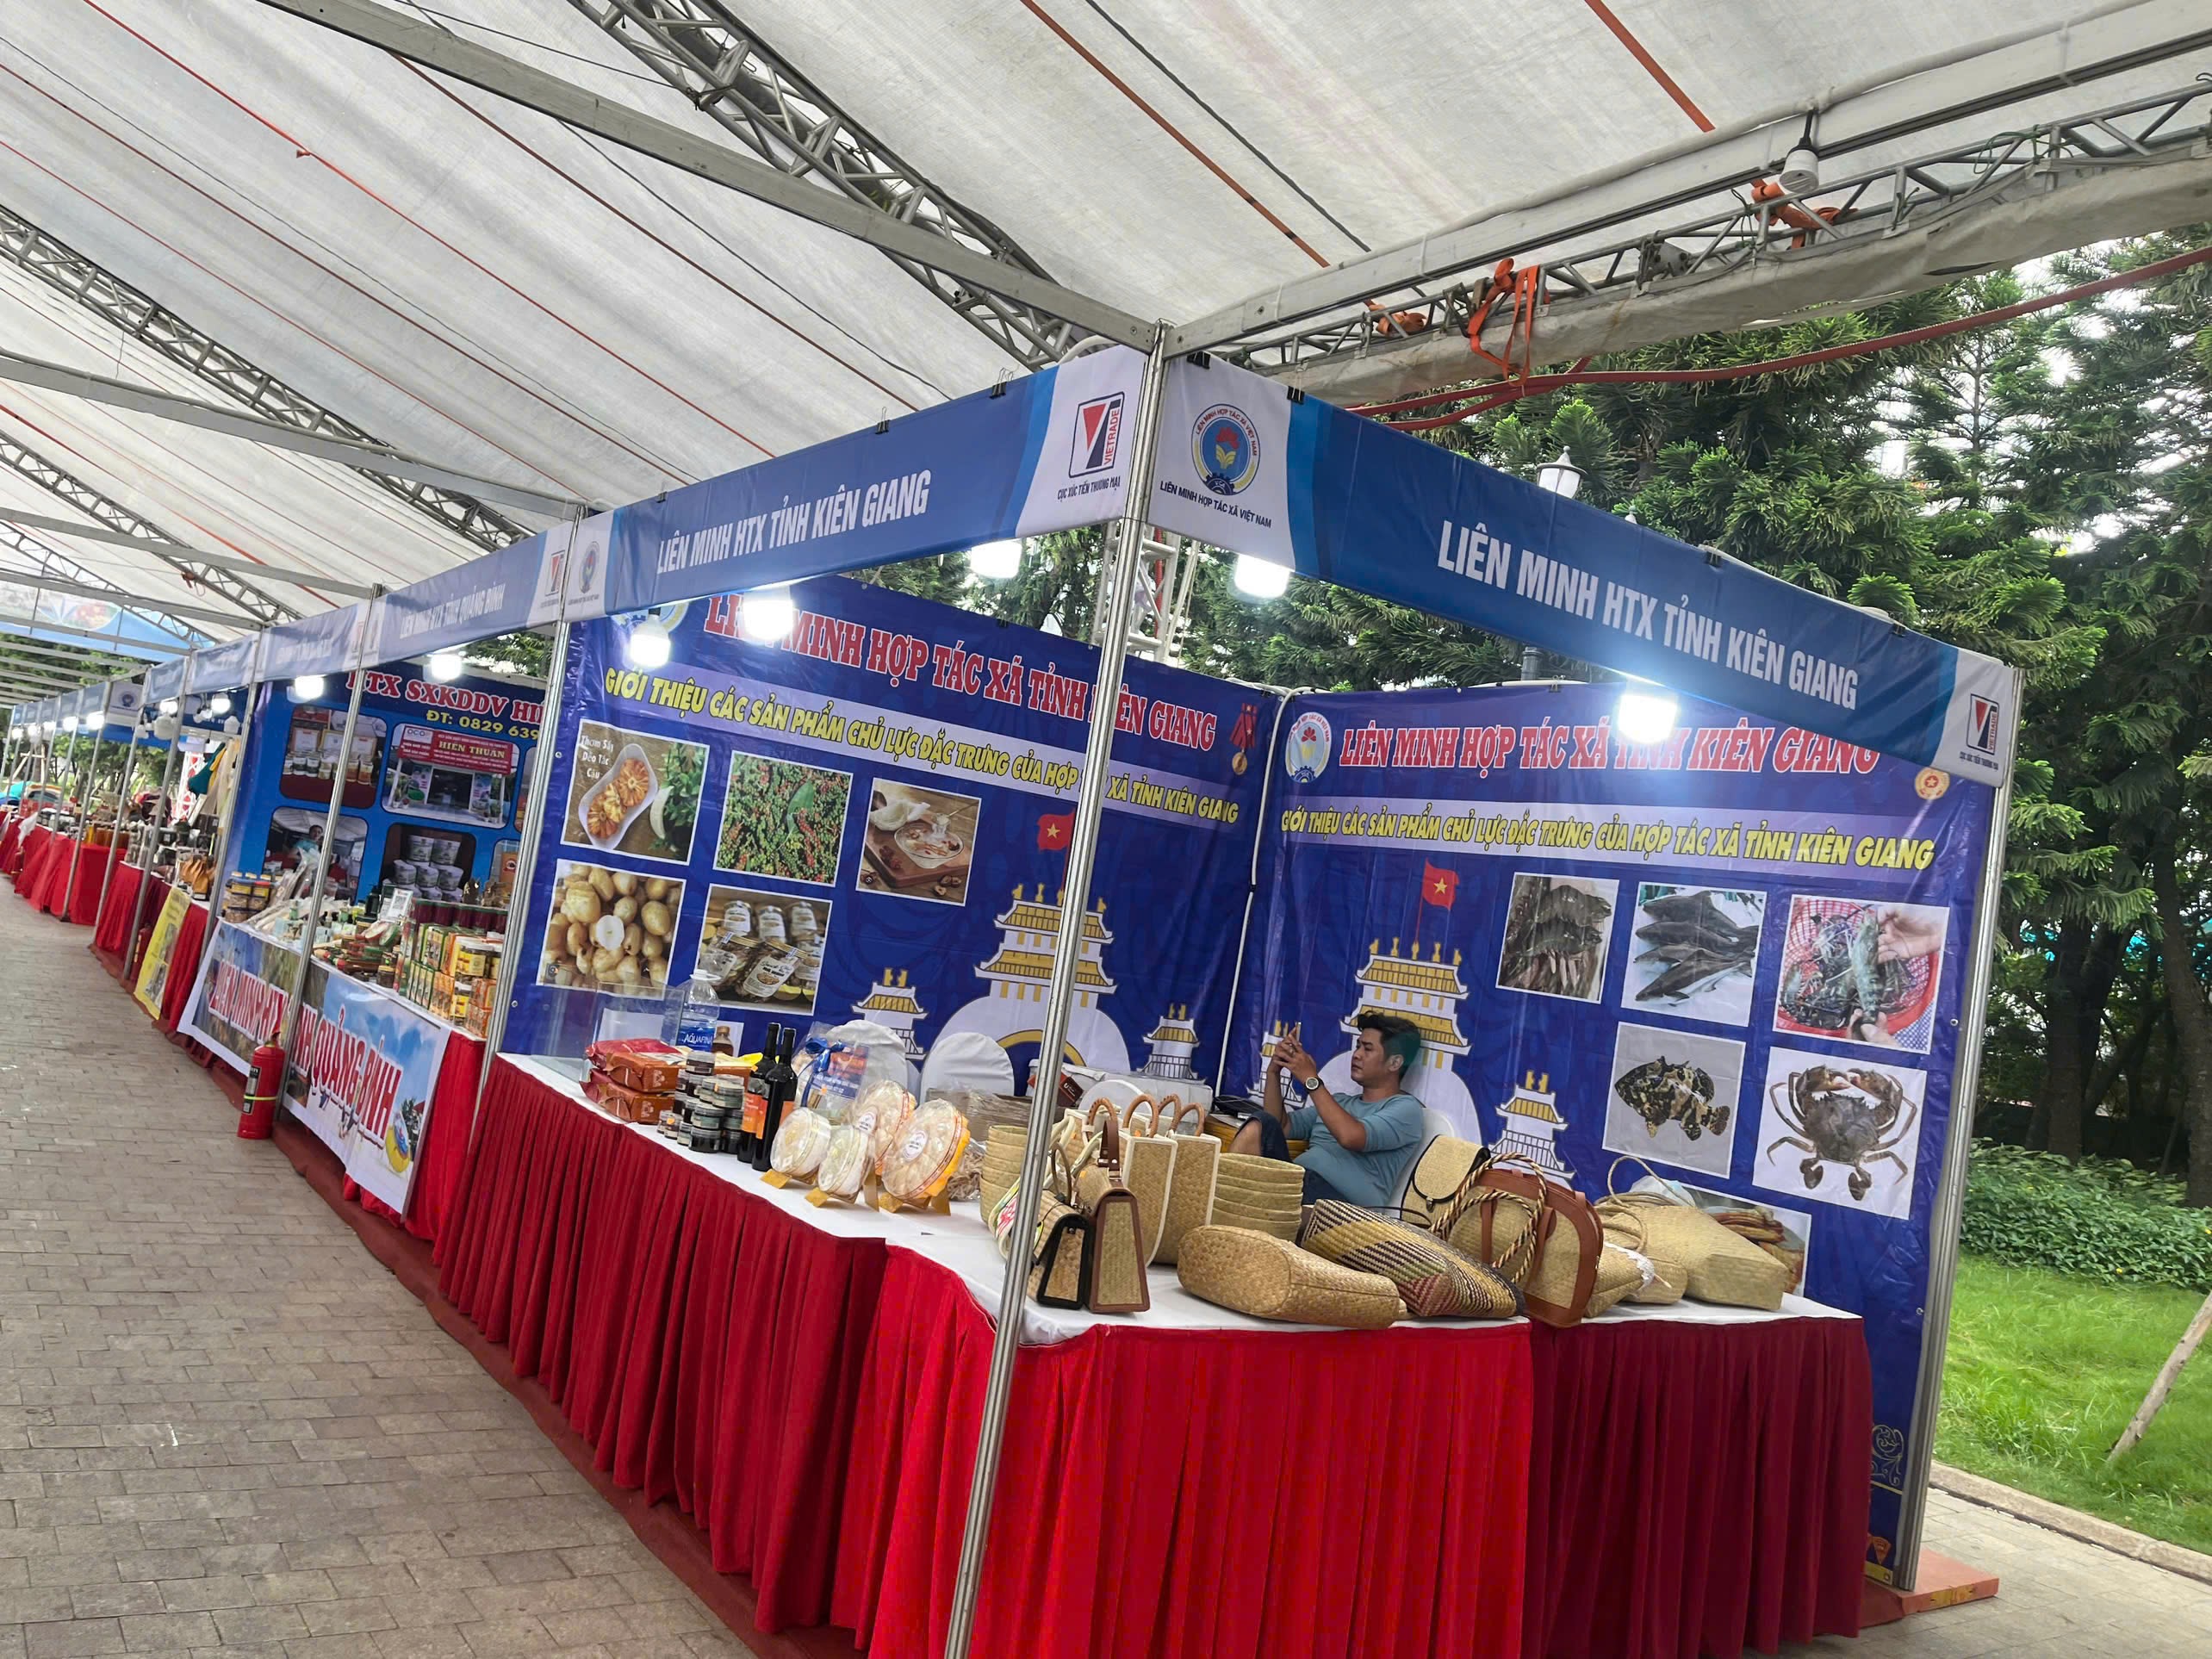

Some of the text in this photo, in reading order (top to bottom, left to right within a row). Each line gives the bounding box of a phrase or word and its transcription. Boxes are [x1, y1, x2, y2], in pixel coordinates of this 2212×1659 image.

[1103, 409, 1120, 465] VIETRADE
[1229, 409, 1241, 420] TÁC
[657, 469, 931, 574] LIÊN MINH HTX TỈNH KIÊN GIANG
[1159, 481, 1272, 528] LIÊN MINH HỢP TÁC XÃ VIỆT NAM
[1438, 519, 1858, 710] LIÊN MINH HTX TỈNH KIÊN GIANG
[405, 679, 509, 718] SXKDDV
[780, 608, 867, 668] MINH
[866, 627, 929, 687] HỢP
[932, 640, 984, 696] TÁC
[983, 655, 1024, 706] XÃ
[1028, 662, 1088, 722] TỈNH
[1148, 699, 1218, 751] GIANG
[426, 710, 453, 724] ĐT:
[459, 717, 504, 733] 0829
[649, 676, 709, 718] THIỆU
[709, 685, 749, 723] CÁC
[749, 693, 791, 730] SẢN
[790, 699, 846, 743] PHẨM
[847, 716, 885, 750] CHỦ
[885, 726, 919, 762] LỰC
[917, 727, 955, 770] ĐẶC
[954, 743, 1010, 777] TRƯNG
[1011, 749, 1043, 784] CỦA
[1043, 761, 1078, 795] HỢP
[1339, 720, 1393, 767] LIÊN
[1391, 727, 1460, 767] MINH
[1459, 724, 1516, 779] HỢP
[1519, 717, 1569, 769] TÁC
[1568, 716, 1610, 769] XÃ
[1686, 717, 1775, 774] KIÊN
[1773, 727, 1880, 774] GIANG
[1987, 712, 1997, 750] VIETRADE
[1105, 773, 1130, 802] XÃ
[1130, 774, 1165, 808] TỈNH
[1165, 786, 1198, 816] KIÊN
[1197, 796, 1240, 823] GIANG
[1281, 803, 1936, 870] GIỚI THIỆU CÁC SẢN PHẨM CHỦ LỰC ĐẶC TRƯNG CỦA HỢP TÁC XÃ TỈNH KIÊN GIANG
[311, 1003, 366, 1111] QUẢNG
[355, 1035, 403, 1147] BÌNH
